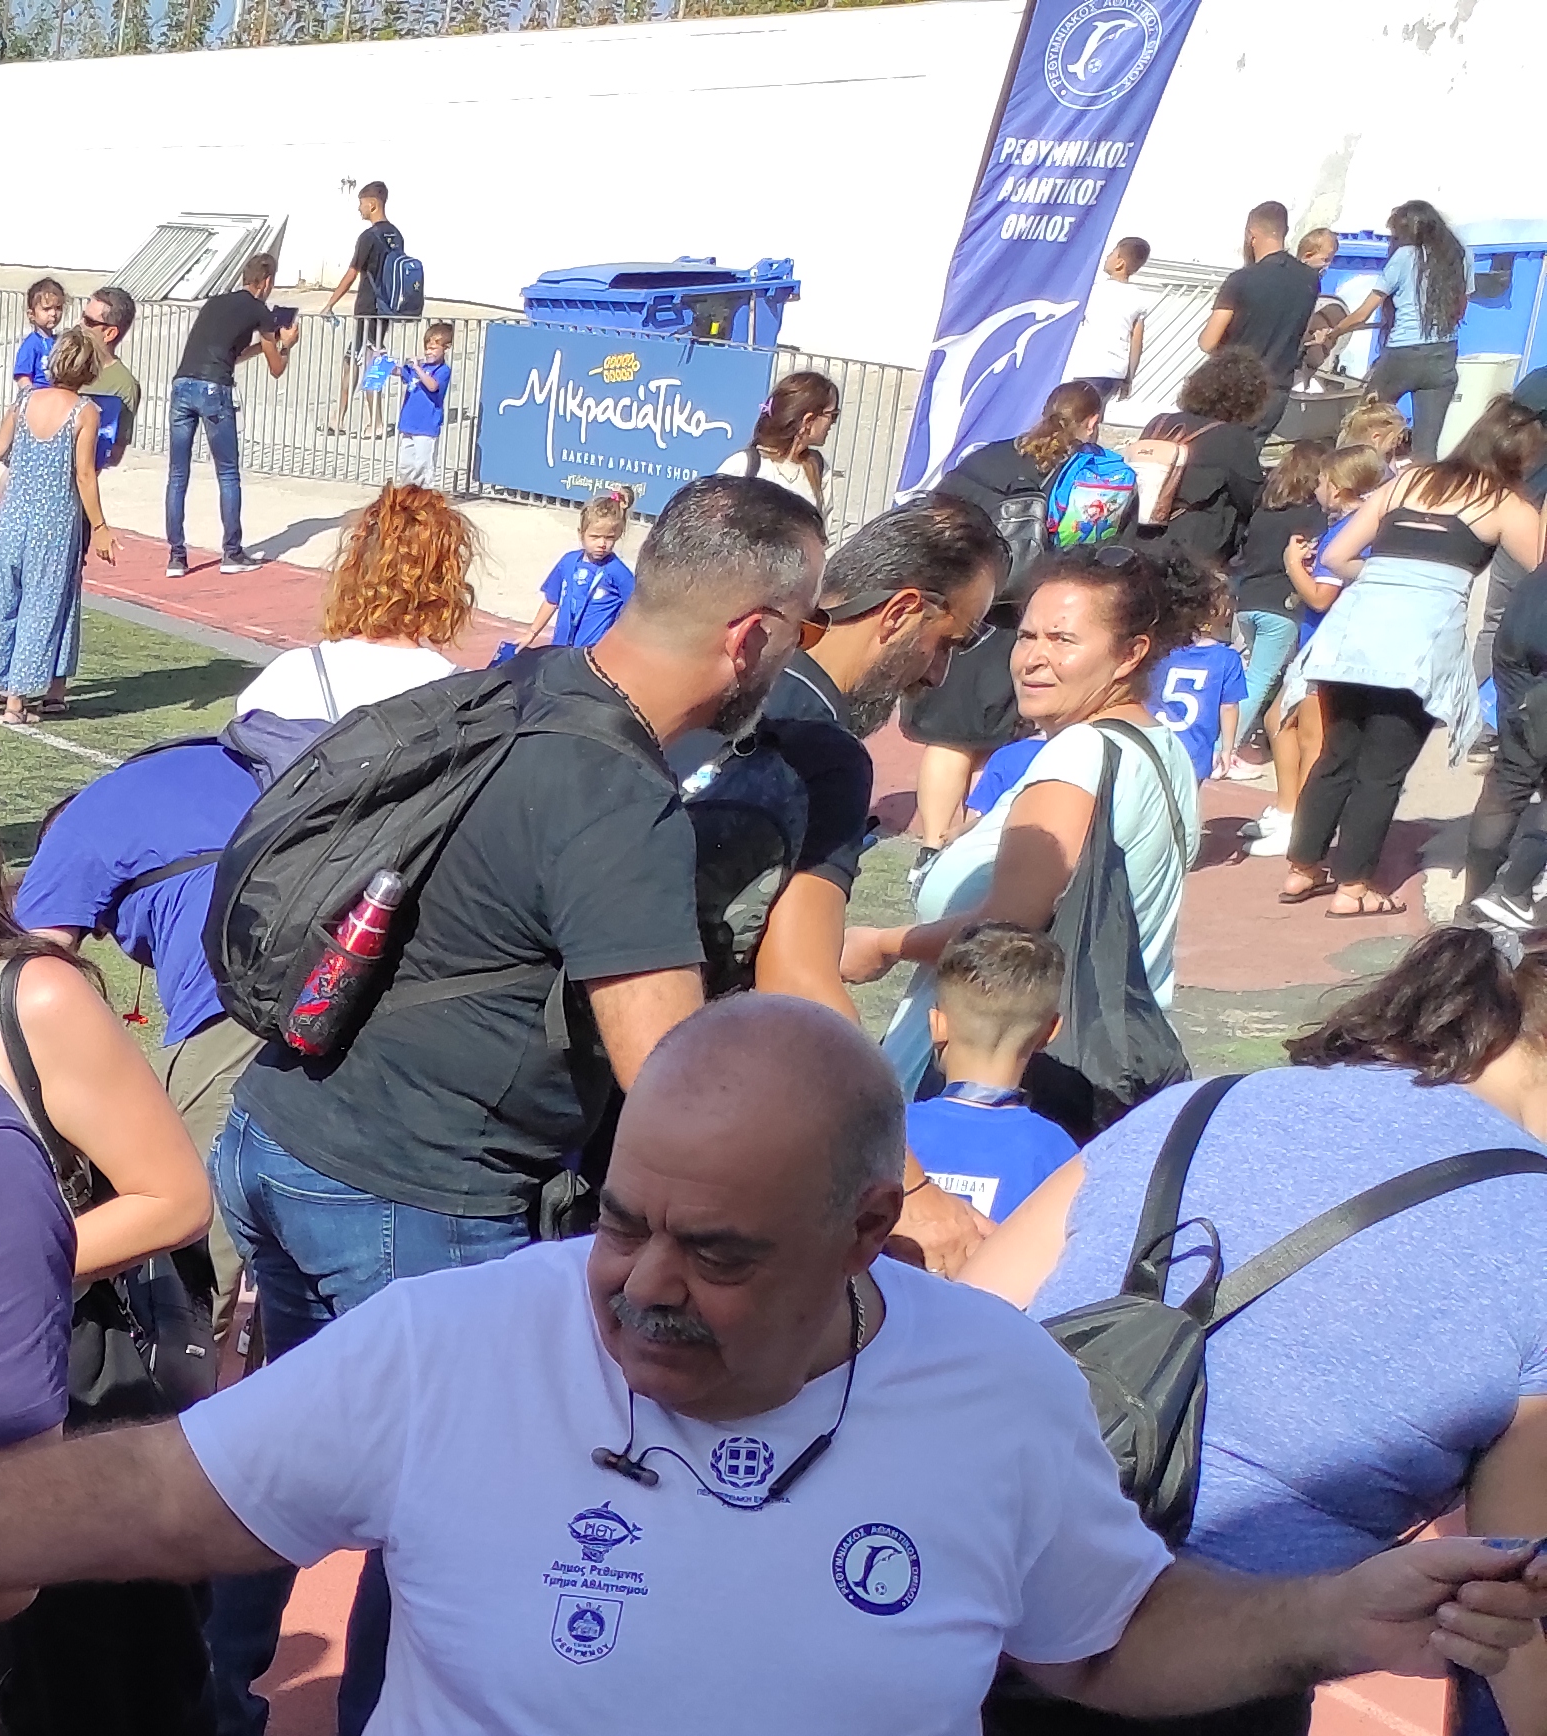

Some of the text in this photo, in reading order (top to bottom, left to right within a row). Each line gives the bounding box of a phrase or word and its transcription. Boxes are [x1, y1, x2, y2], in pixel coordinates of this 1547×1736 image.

[999, 137, 1134, 168] ΡΕΘΥΜΝΙΑΚΟΣ
[997, 175, 1106, 206] ΑΘΛΗΤΙΚΟΣ
[1000, 213, 1076, 243] ΟΜΙΛΟΣ
[561, 449, 605, 467] BAKERY
[619, 457, 663, 476] PASTRY
[666, 465, 699, 482] SHOP
[1155, 667, 1209, 732] 5
[542, 1573, 578, 1589] Τμήμα
[550, 1560, 586, 1577] Δήμος
